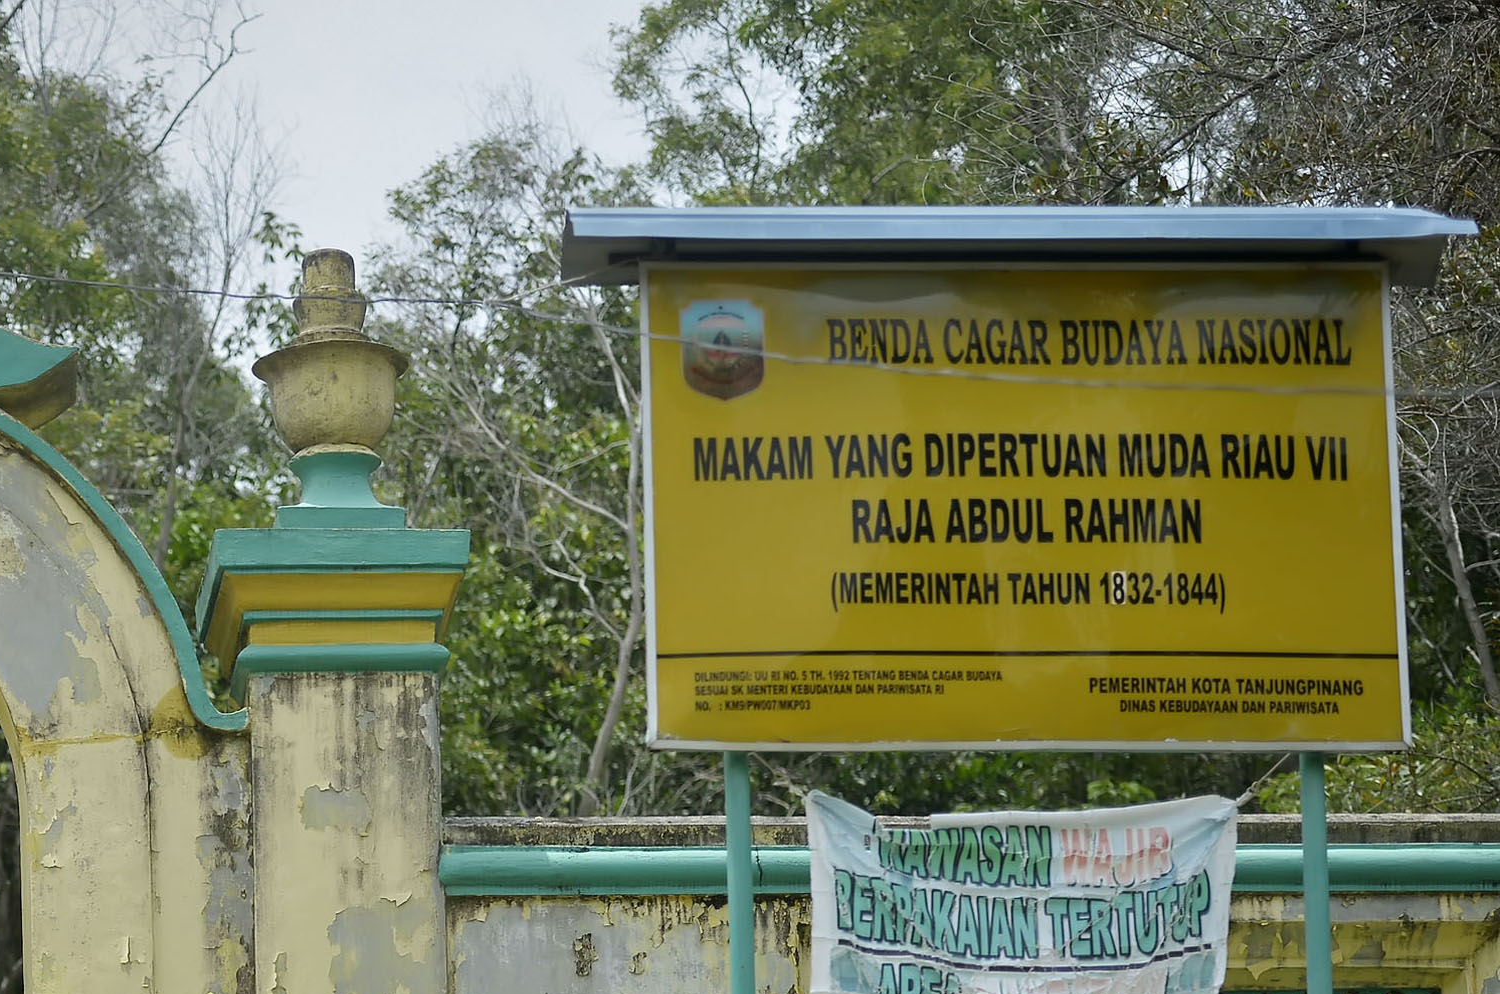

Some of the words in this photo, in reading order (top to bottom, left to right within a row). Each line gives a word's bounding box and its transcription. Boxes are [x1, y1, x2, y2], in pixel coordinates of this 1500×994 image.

[827, 319, 934, 364] BENDA
[943, 319, 1052, 365] CAGAR
[1061, 319, 1188, 365] BUDAYA
[1196, 319, 1352, 366] NASIONAL
[693, 436, 813, 481] MAKAM
[825, 433, 912, 479] YANG
[924, 433, 1107, 478] DIPERTUAN
[1118, 433, 1211, 478] MUDA
[1220, 433, 1295, 480] RIAU
[1305, 436, 1348, 481] VII
[852, 498, 936, 543] RAJA
[946, 498, 1054, 543] ABDUL
[1065, 498, 1203, 543] RAHMAN
[831, 572, 999, 612] (MEMERINTAH
[1007, 572, 1091, 605] TAHUN
[1100, 571, 1226, 614] 1832-1844)
[694, 684, 729, 696] SESUAI
[730, 684, 744, 696] SK
[746, 684, 788, 696] MENTERI
[790, 683, 853, 695] KEBUDAYAAN
[856, 683, 875, 695] DAN
[877, 683, 932, 695] PARIWISATA
[934, 683, 944, 695] RI
[755, 670, 768, 683] UU
[771, 670, 781, 683] RI
[783, 670, 799, 683] NO.
[801, 670, 808, 683] 5
[810, 670, 825, 683] TH.
[828, 670, 850, 683] 1992
[853, 670, 896, 683] TENTANG
[898, 670, 930, 683] BENDA
[931, 670, 964, 683] CAGAR
[966, 670, 1002, 682] BUDAYA
[1089, 677, 1187, 694] PEMERINTAH
[1192, 678, 1231, 695] KOTA
[1236, 678, 1364, 696] TANJUNGPINANG
[695, 700, 712, 712] NO.
[1120, 699, 1156, 713] DINAS
[1159, 700, 1238, 714] KEBUDAYAAN
[1242, 701, 1266, 714] DAN
[1269, 702, 1339, 715] PARIWISATA
[876, 824, 1053, 888] KAWASAN
[1059, 826, 1175, 888] WAJIB
[833, 867, 1040, 959] BERPAKAIAN
[1044, 869, 1212, 959] TERTUTUP
